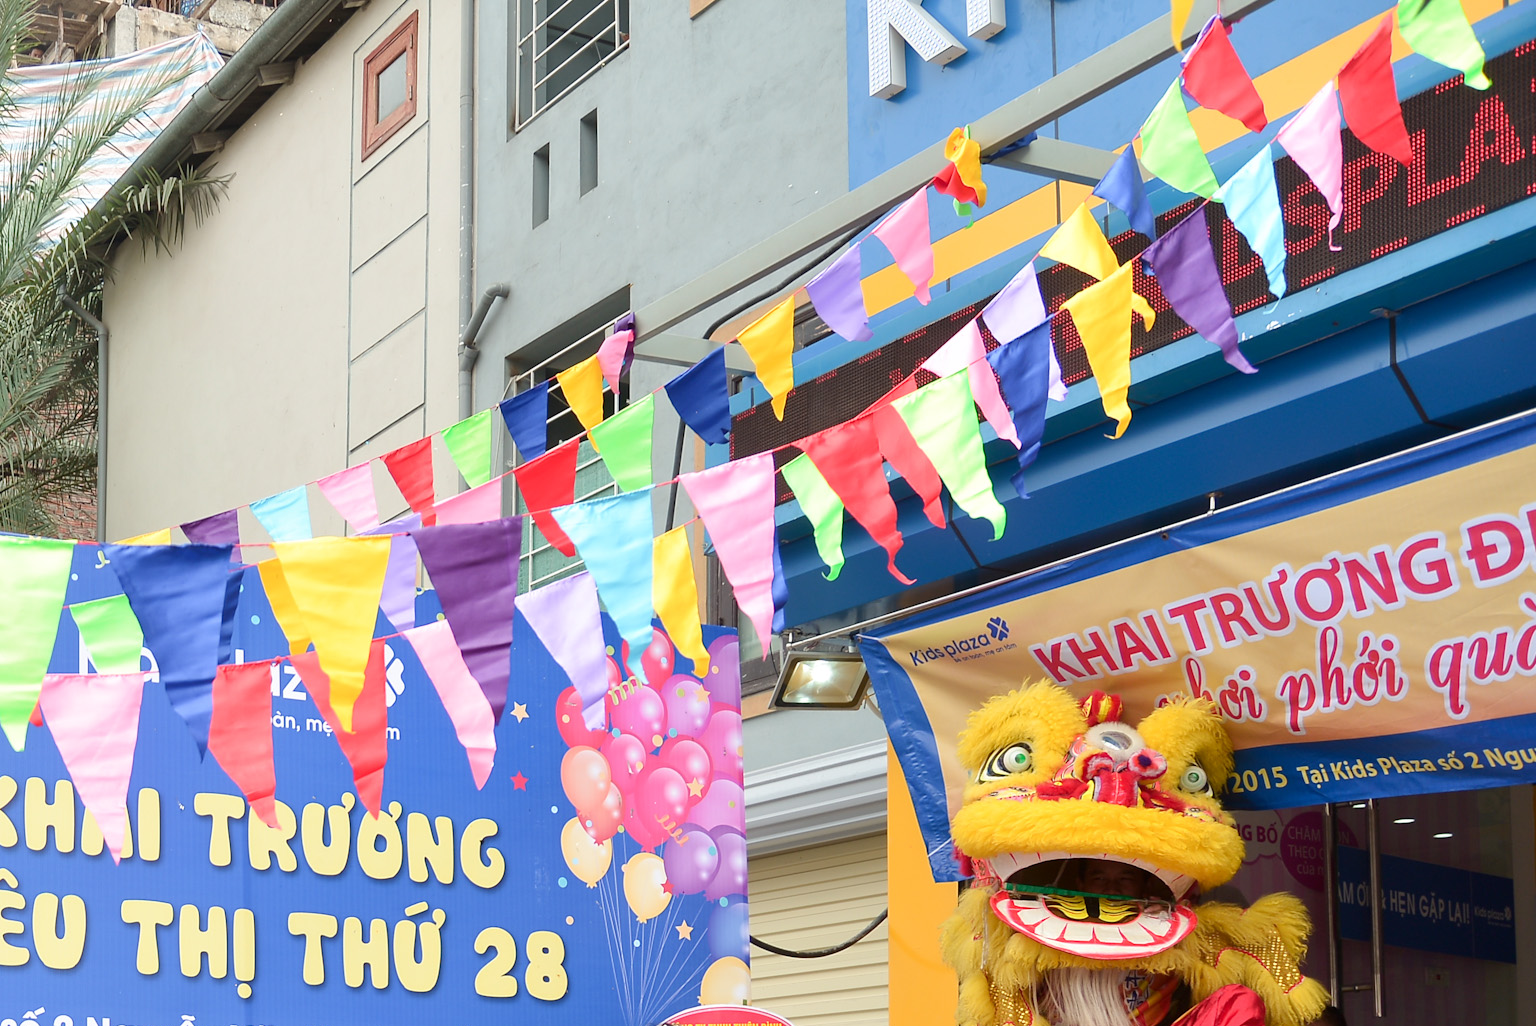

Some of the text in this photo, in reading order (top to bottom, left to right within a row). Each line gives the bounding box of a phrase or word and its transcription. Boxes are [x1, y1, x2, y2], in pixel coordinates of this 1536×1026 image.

[910, 633, 991, 666] Kids plaza
[1033, 615, 1172, 683] KHAI
[1168, 537, 1453, 651] TRƯƠNG
[1280, 626, 1404, 733] phới
[1226, 747, 1536, 794] 2015 Tại Kids Plaza số 2 Ngu
[194, 792, 506, 888] TRƯƠNG
[121, 899, 256, 999] THỊ
[287, 901, 446, 992] THỨ
[473, 927, 569, 1001] 28
[1389, 891, 1415, 917] HẸN
